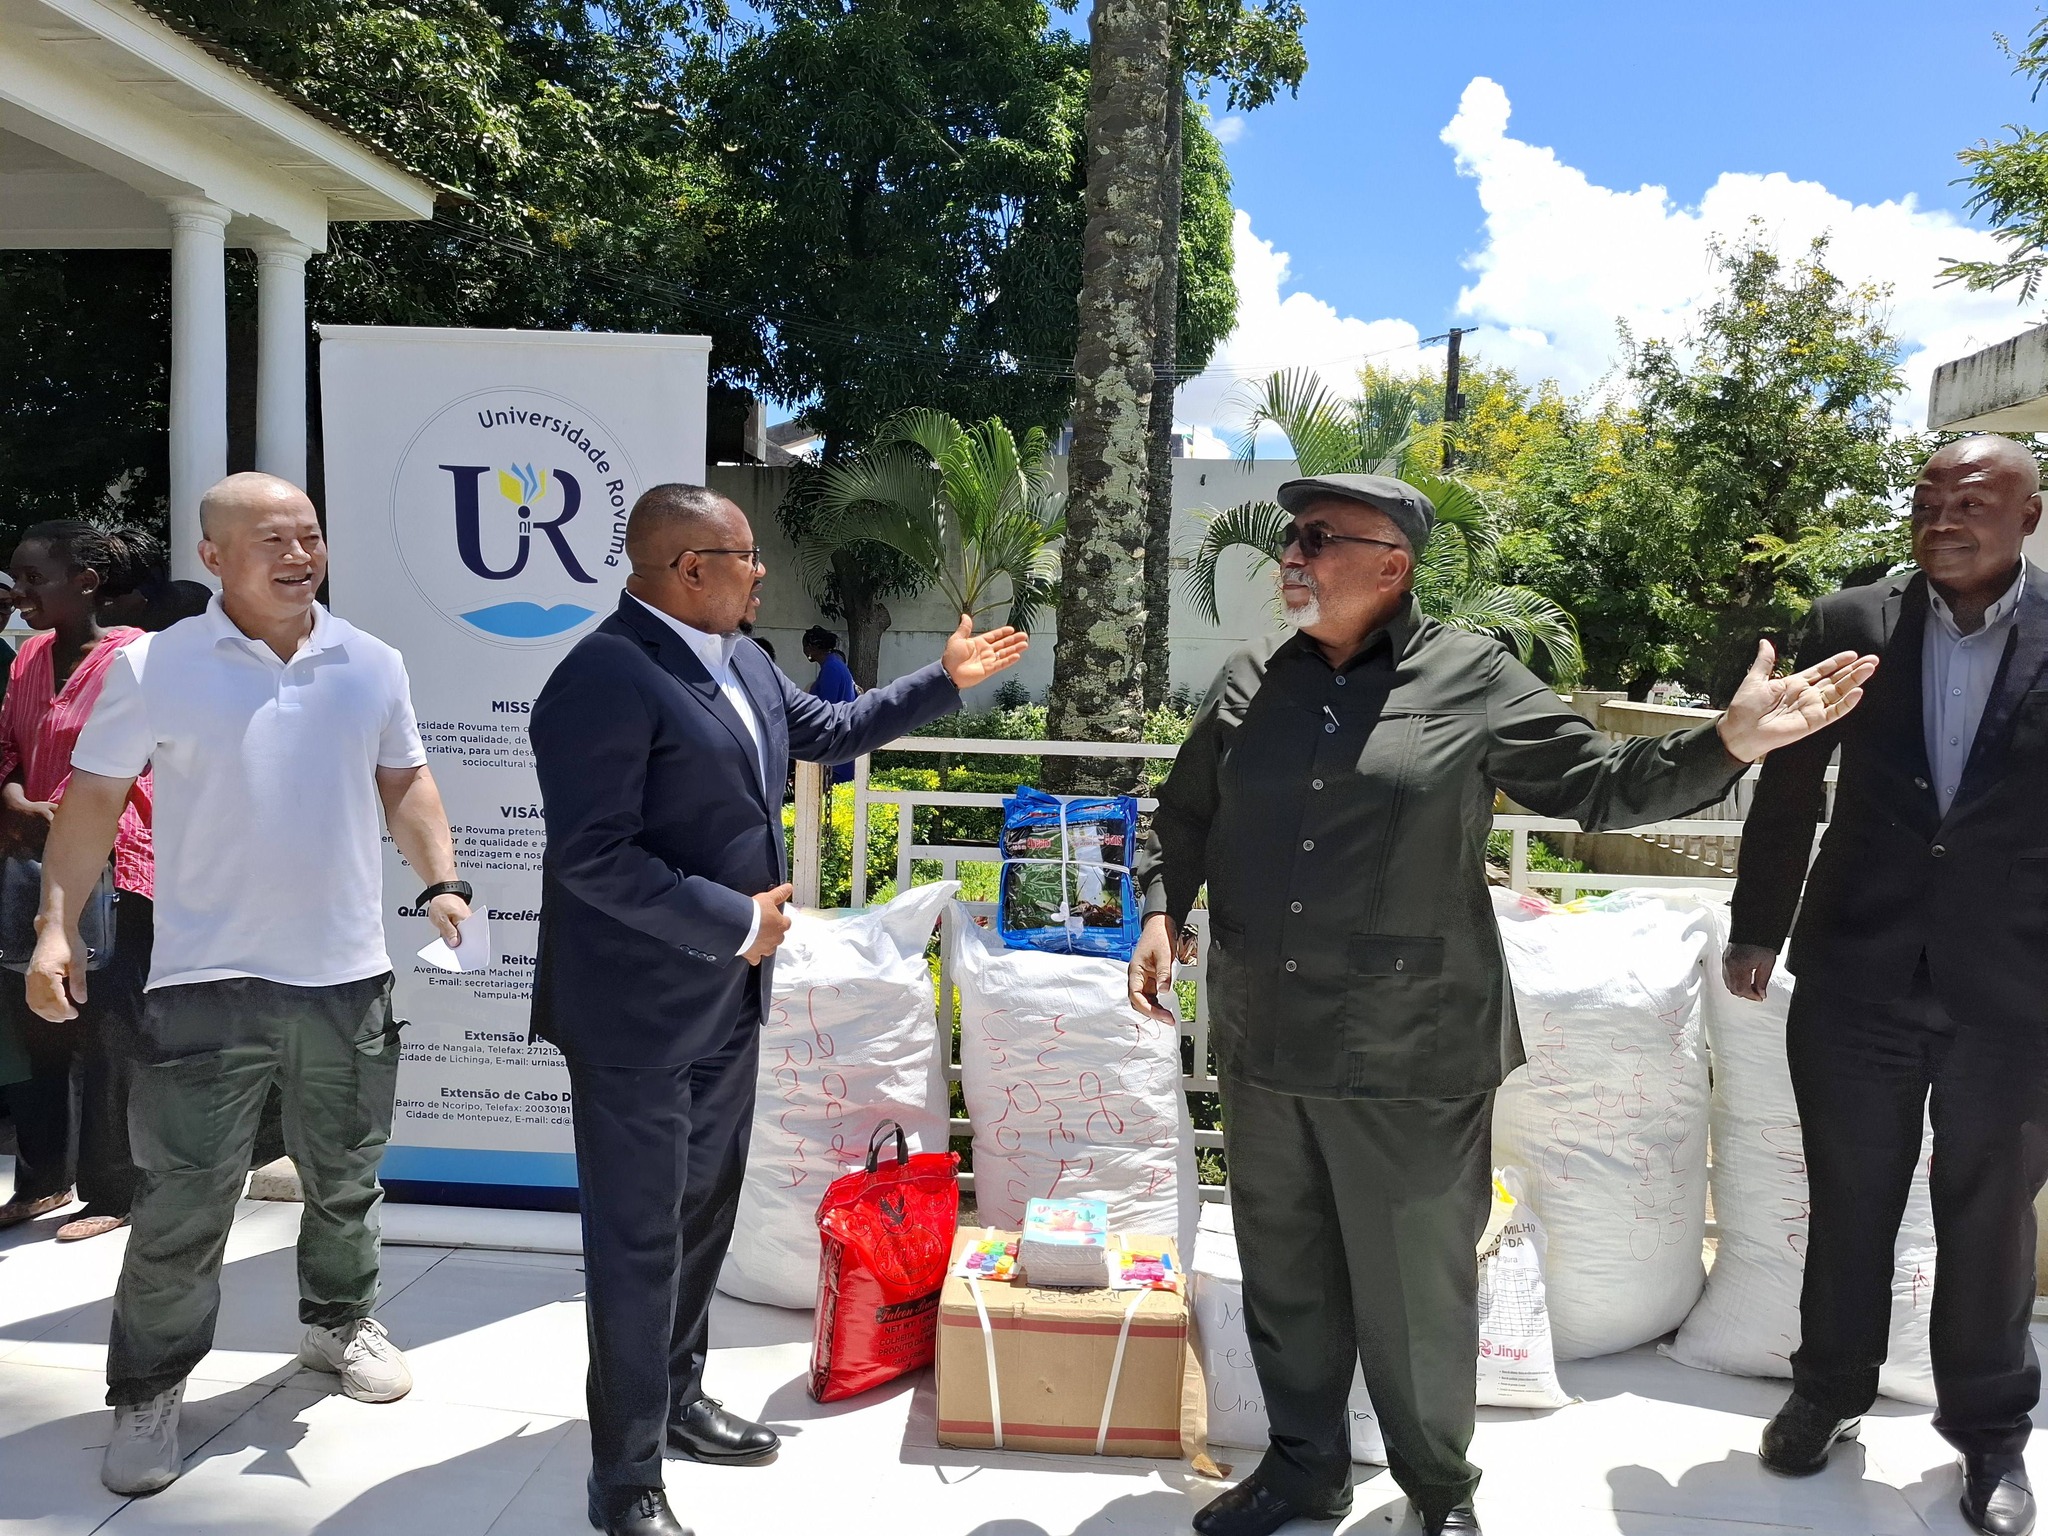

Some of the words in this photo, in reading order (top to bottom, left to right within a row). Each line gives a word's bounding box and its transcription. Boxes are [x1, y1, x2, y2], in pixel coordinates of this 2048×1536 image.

[478, 406, 610, 474] Universidade
[604, 479, 627, 569] Rovuma
[491, 700, 538, 714] MISS
[417, 721, 455, 731] rsidade
[458, 722, 498, 732] Rovuma
[500, 724, 521, 733] tem
[420, 733, 433, 742] es
[436, 735, 457, 743] com
[460, 734, 512, 745] qualidade,
[514, 736, 527, 745] de
[426, 744, 466, 755] criativa,
[469, 747, 491, 756] para
[493, 748, 510, 756] um
[512, 748, 536, 757] dese
[462, 757, 526, 768] sociocultural
[450, 825, 463, 834] de
[465, 825, 505, 836] Rovuma
[381, 835, 394, 843] en
[464, 837, 477, 846] de
[479, 838, 530, 848] qualidade
[453, 848, 513, 859] rendizagem
[523, 852, 542, 860] nos
[460, 859, 484, 869] nível
[485, 861, 531, 872] nacional,
[397, 907, 430, 918] Qual
[487, 908, 541, 922] Excelên
[501, 954, 537, 966] Reito
[488, 968, 524, 978] Machel
[428, 977, 462, 987] E-mail:
[464, 979, 534, 990] secretariagera
[464, 1030, 525, 1043] Extensão
[400, 1043, 426, 1052] airro
[427, 1043, 440, 1052] de
[443, 1043, 486, 1054] Nangala,
[488, 1045, 525, 1056] Telefax:
[527, 1047, 564, 1057] 271215
[398, 1052, 432, 1063] Cidade
[434, 1054, 447, 1063] de
[449, 1054, 493, 1066] Lichinga,
[496, 1057, 530, 1067] E-mail:
[531, 1058, 568, 1068] urniass
[440, 1086, 500, 1100] Extensão
[504, 1089, 521, 1101] de
[524, 1090, 558, 1102] Cabo
[561, 1091, 571, 1102] D
[395, 1098, 426, 1109] Bairro
[427, 1100, 440, 1109] de
[442, 1100, 483, 1112] Ncoripo,
[485, 1102, 523, 1113] Telefax:
[405, 1110, 440, 1121] Cidade
[442, 1112, 455, 1121] de
[456, 1112, 513, 1124] Montepuez,
[514, 1115, 549, 1125] E-mail:
[550, 1116, 572, 1126] cd@
[1503, 1222, 1536, 1236] MILHO
[1501, 1237, 1525, 1248] ADA
[884, 1323, 903, 1335] NET
[879, 1331, 916, 1347] COLHEITA
[878, 1341, 914, 1357] PRODUTO
[1494, 1344, 1529, 1361] Jinyu
[1217, 1347, 1255, 1369] es
